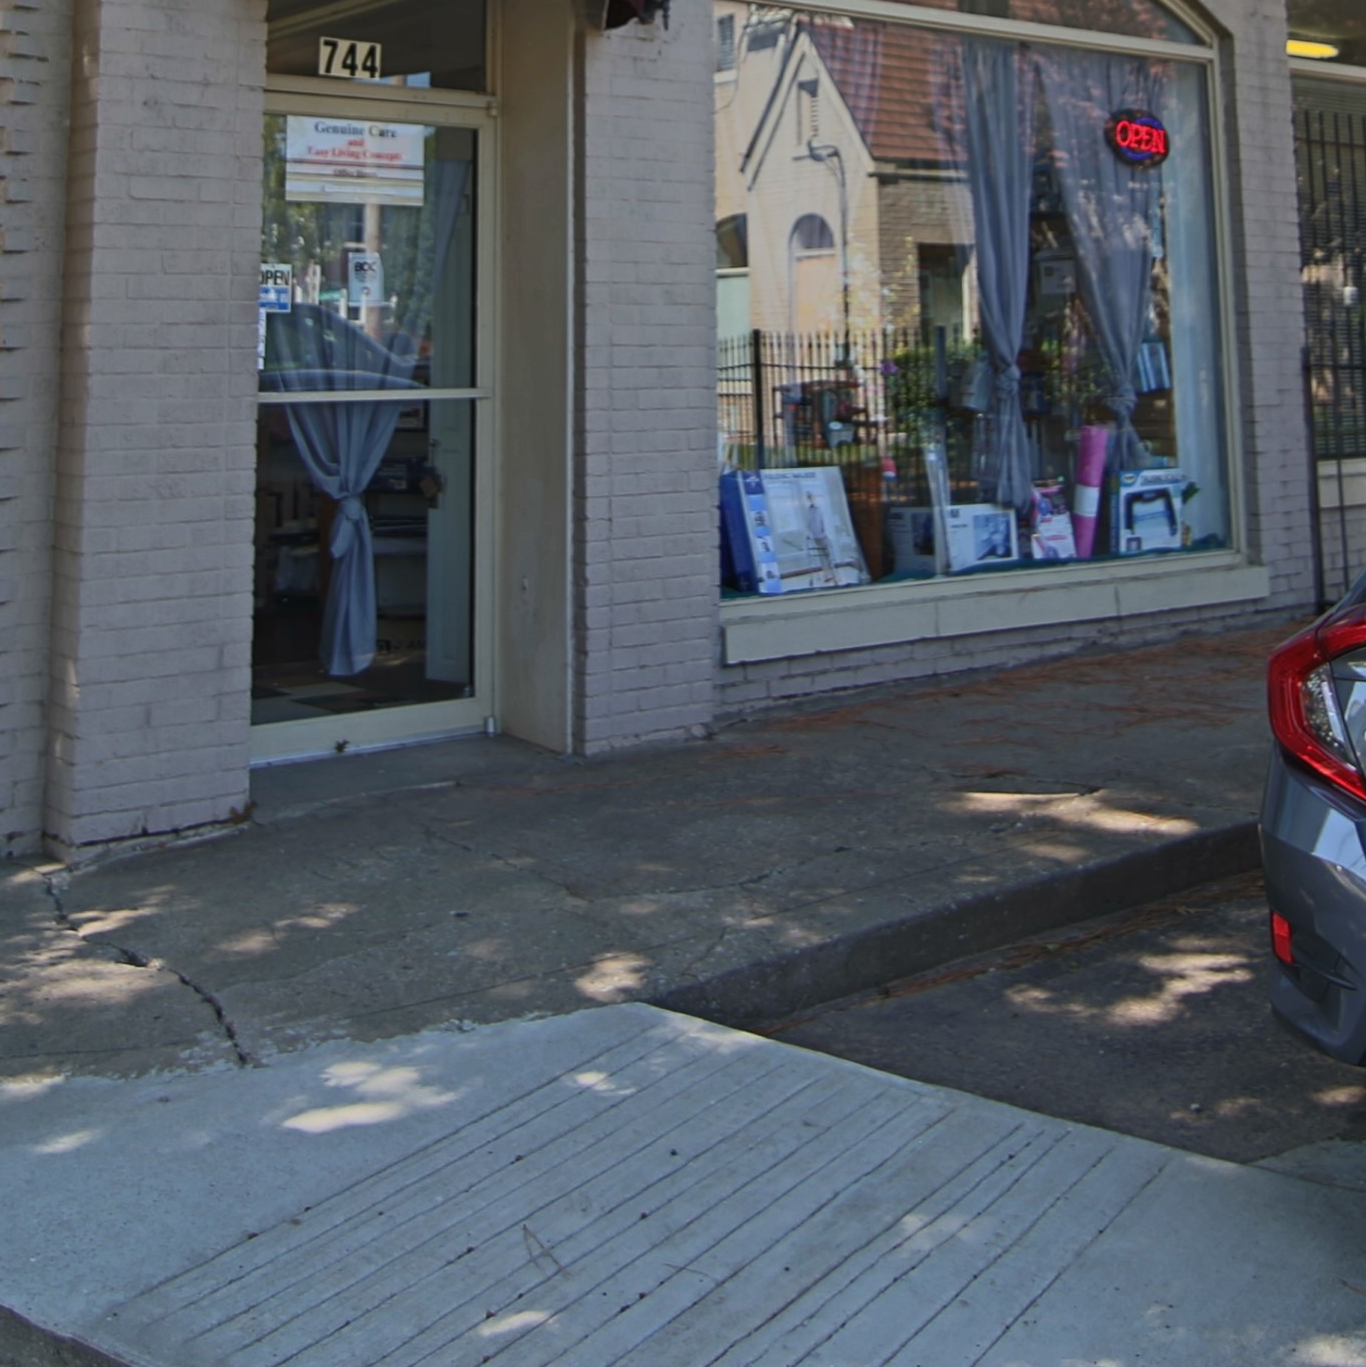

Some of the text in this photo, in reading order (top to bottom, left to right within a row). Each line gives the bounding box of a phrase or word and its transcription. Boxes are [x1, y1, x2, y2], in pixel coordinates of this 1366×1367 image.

[323, 39, 378, 79] 744
[314, 121, 398, 138] Genuine Care
[1115, 120, 1167, 154] OPEN
